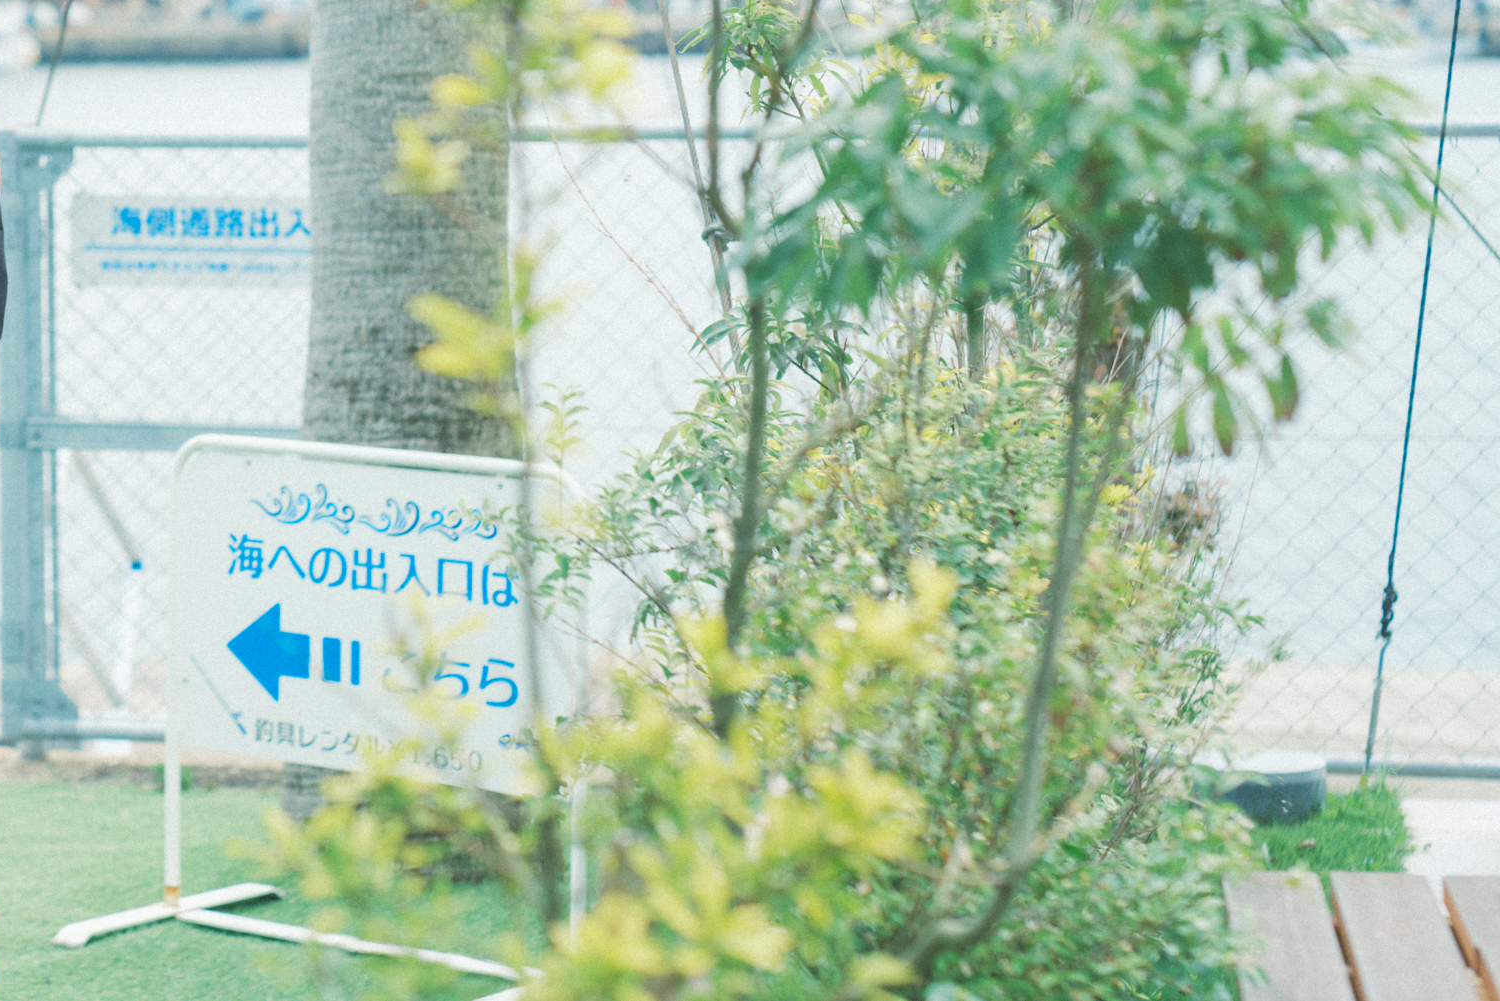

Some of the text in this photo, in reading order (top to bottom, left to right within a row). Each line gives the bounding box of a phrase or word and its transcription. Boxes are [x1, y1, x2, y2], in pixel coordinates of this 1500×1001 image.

[228, 534, 519, 608] 海への出入口は
